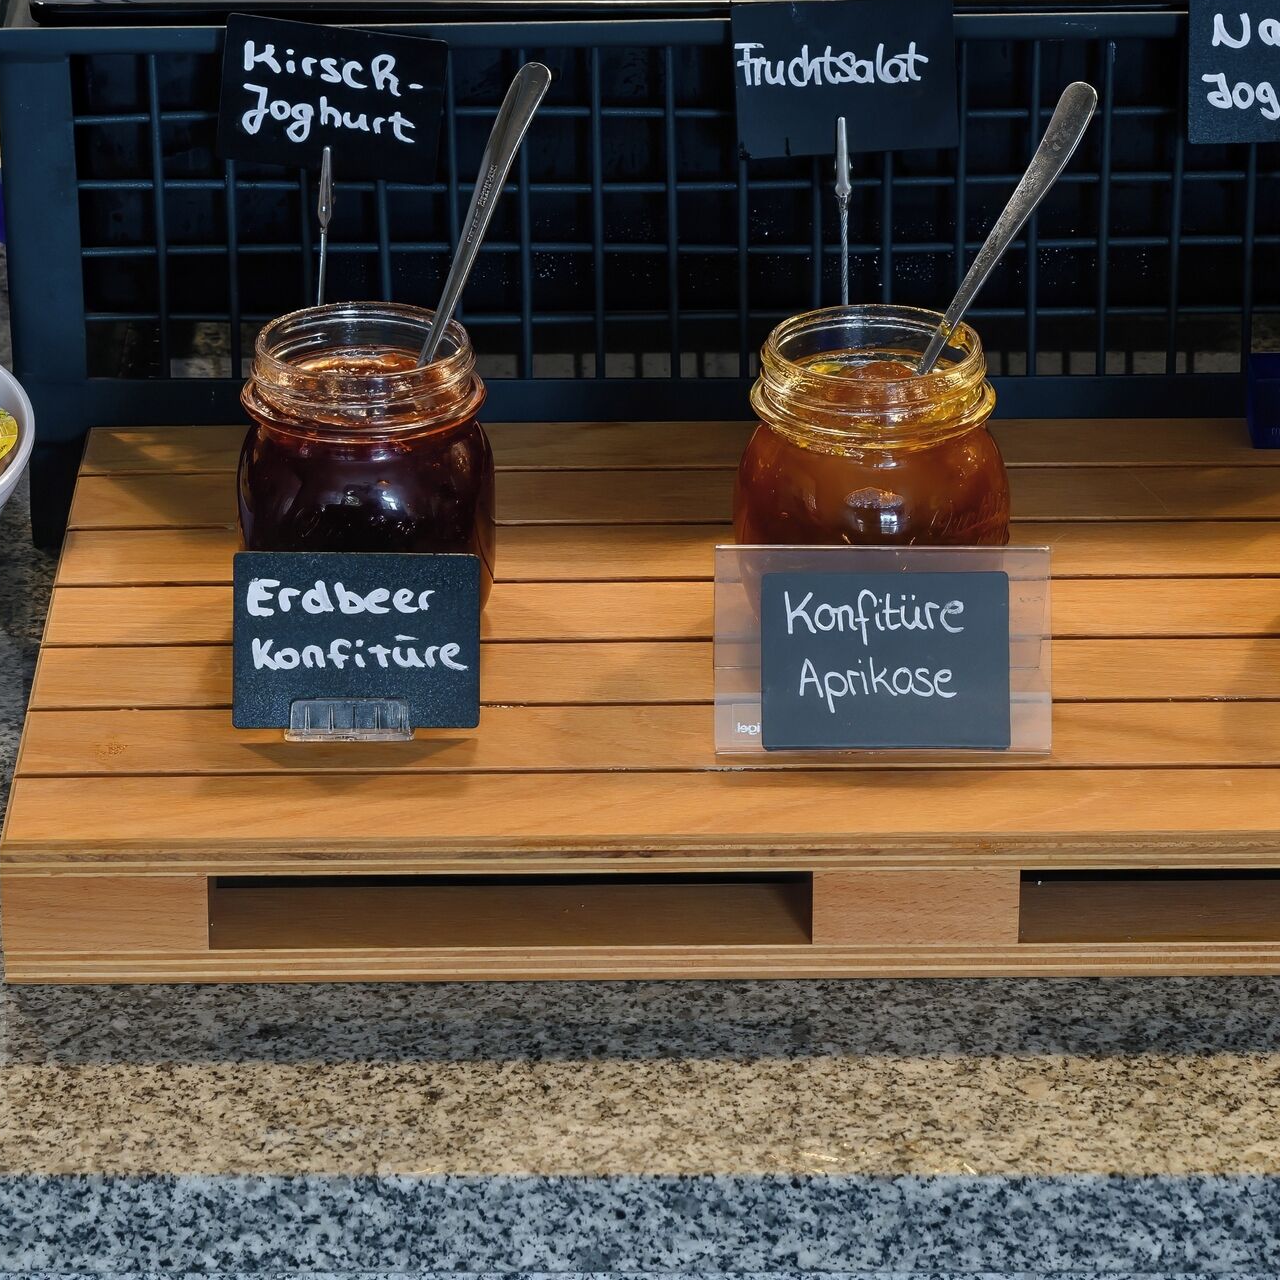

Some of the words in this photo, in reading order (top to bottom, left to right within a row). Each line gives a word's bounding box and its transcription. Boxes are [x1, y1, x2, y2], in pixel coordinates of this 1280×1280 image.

[243, 39, 424, 97] Kirsch-
[734, 40, 929, 88] Fruchtsalat
[241, 82, 416, 144] Joghurt
[246, 578, 435, 617] Erdbeer
[783, 588, 965, 646] Konfitüre
[251, 633, 469, 671] Konfitüre
[798, 656, 957, 714] Aprikose
